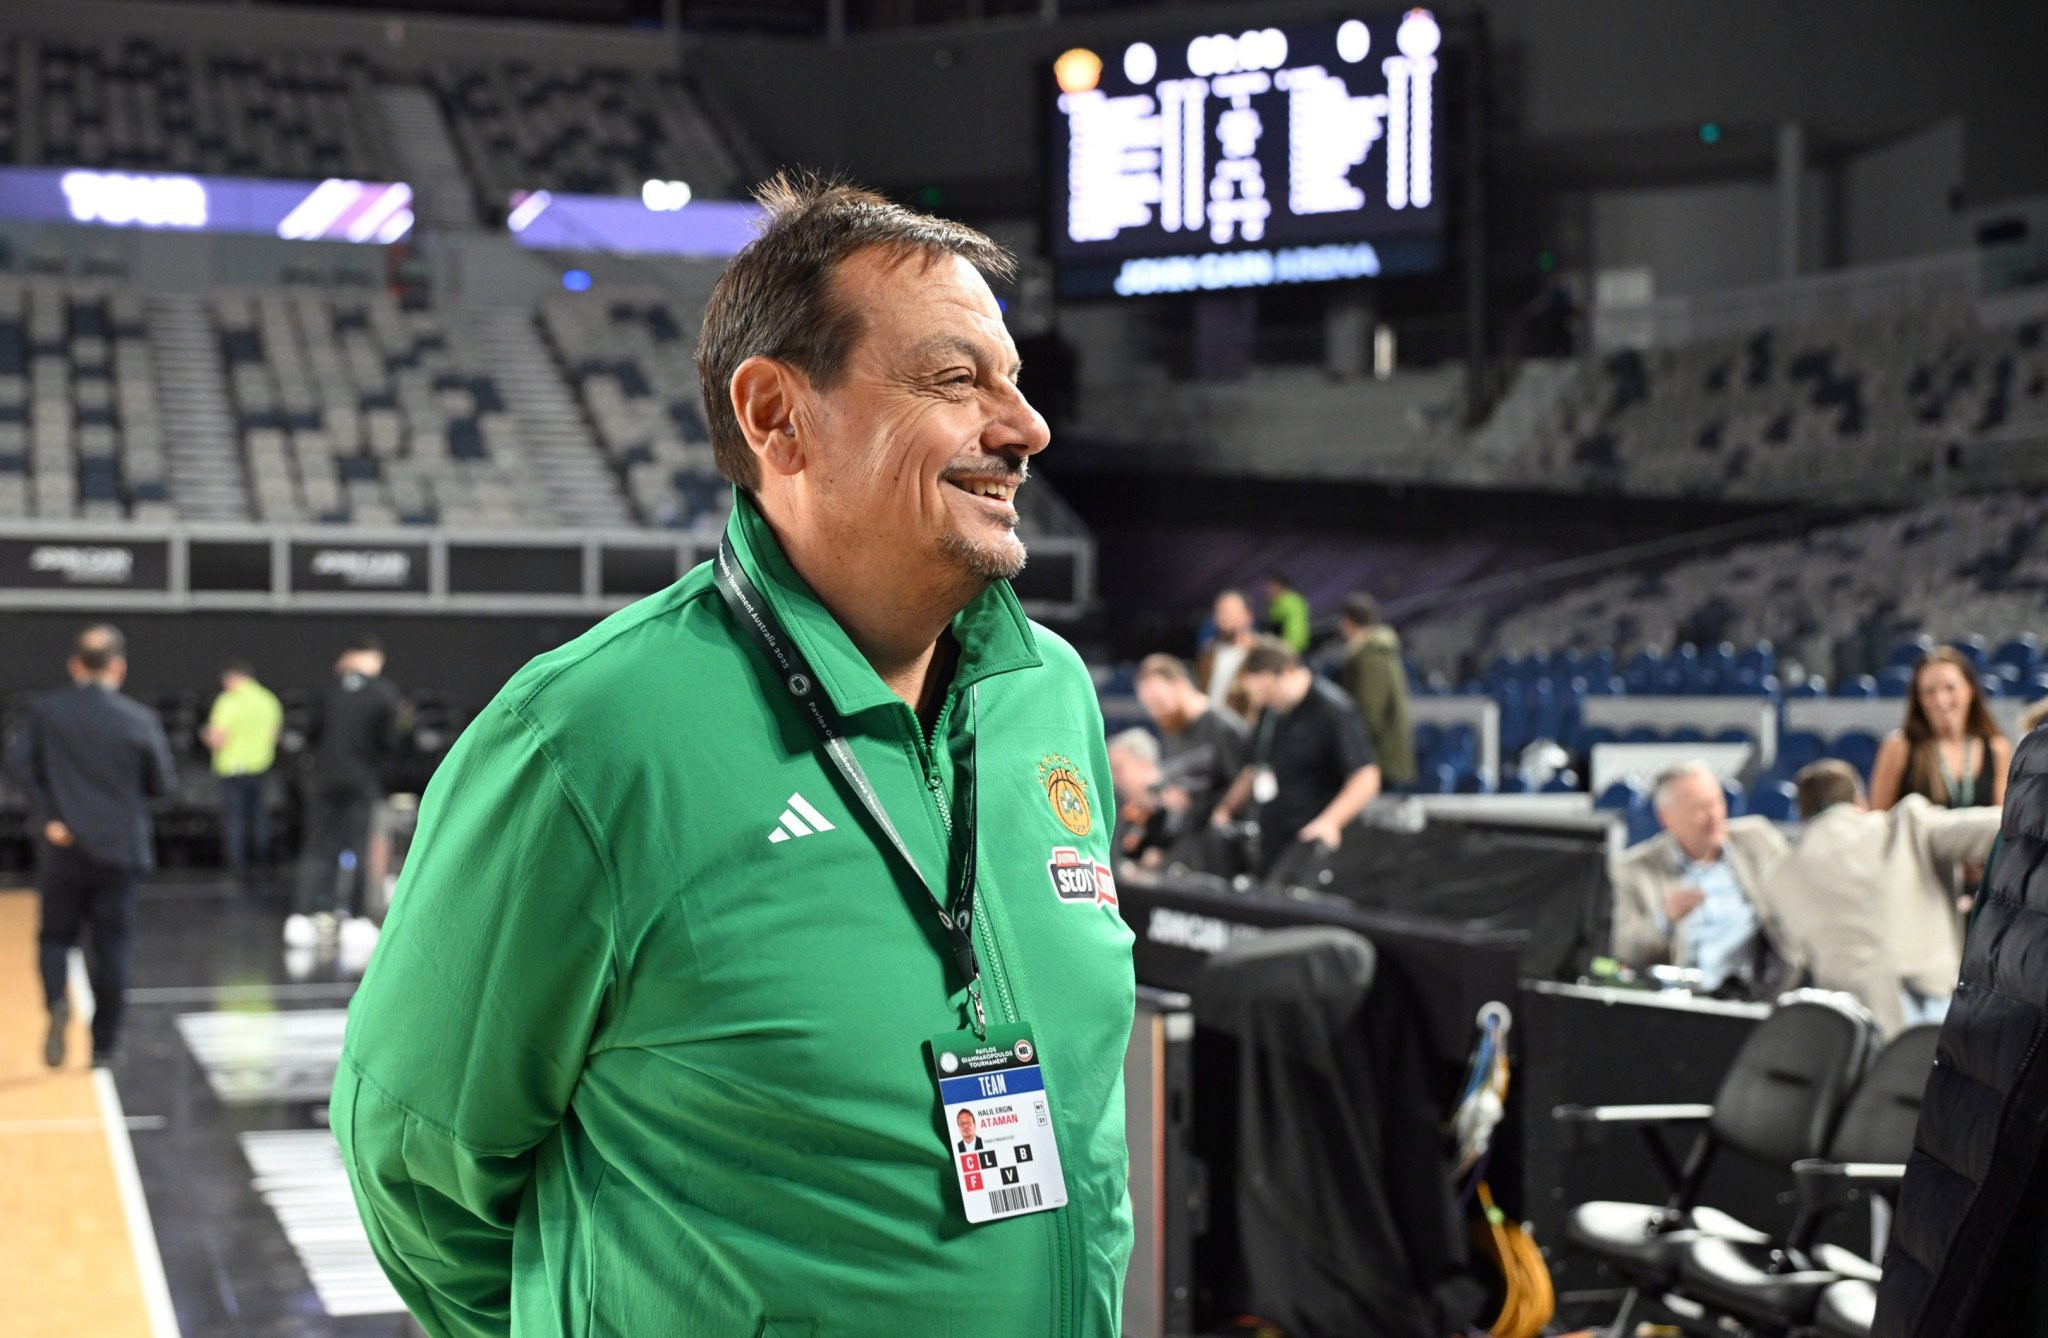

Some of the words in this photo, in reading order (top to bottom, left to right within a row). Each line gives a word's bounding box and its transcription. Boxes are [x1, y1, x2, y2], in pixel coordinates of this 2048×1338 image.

[728, 574, 755, 613] Tournament
[751, 610, 777, 647] Australia
[774, 647, 790, 669] 2025
[808, 702, 828, 729] Pavlos
[961, 1050, 1013, 1063] GIANNAKOPOULOS
[969, 1058, 1008, 1069] TOURNAMENT
[978, 1074, 1007, 1097] TEAM
[980, 1114, 1019, 1128] ATAMAN
[1019, 1147, 1028, 1160] B
[966, 1156, 974, 1169] C
[984, 1154, 992, 1166] L
[970, 1175, 977, 1188] F
[1005, 1169, 1013, 1182] V
